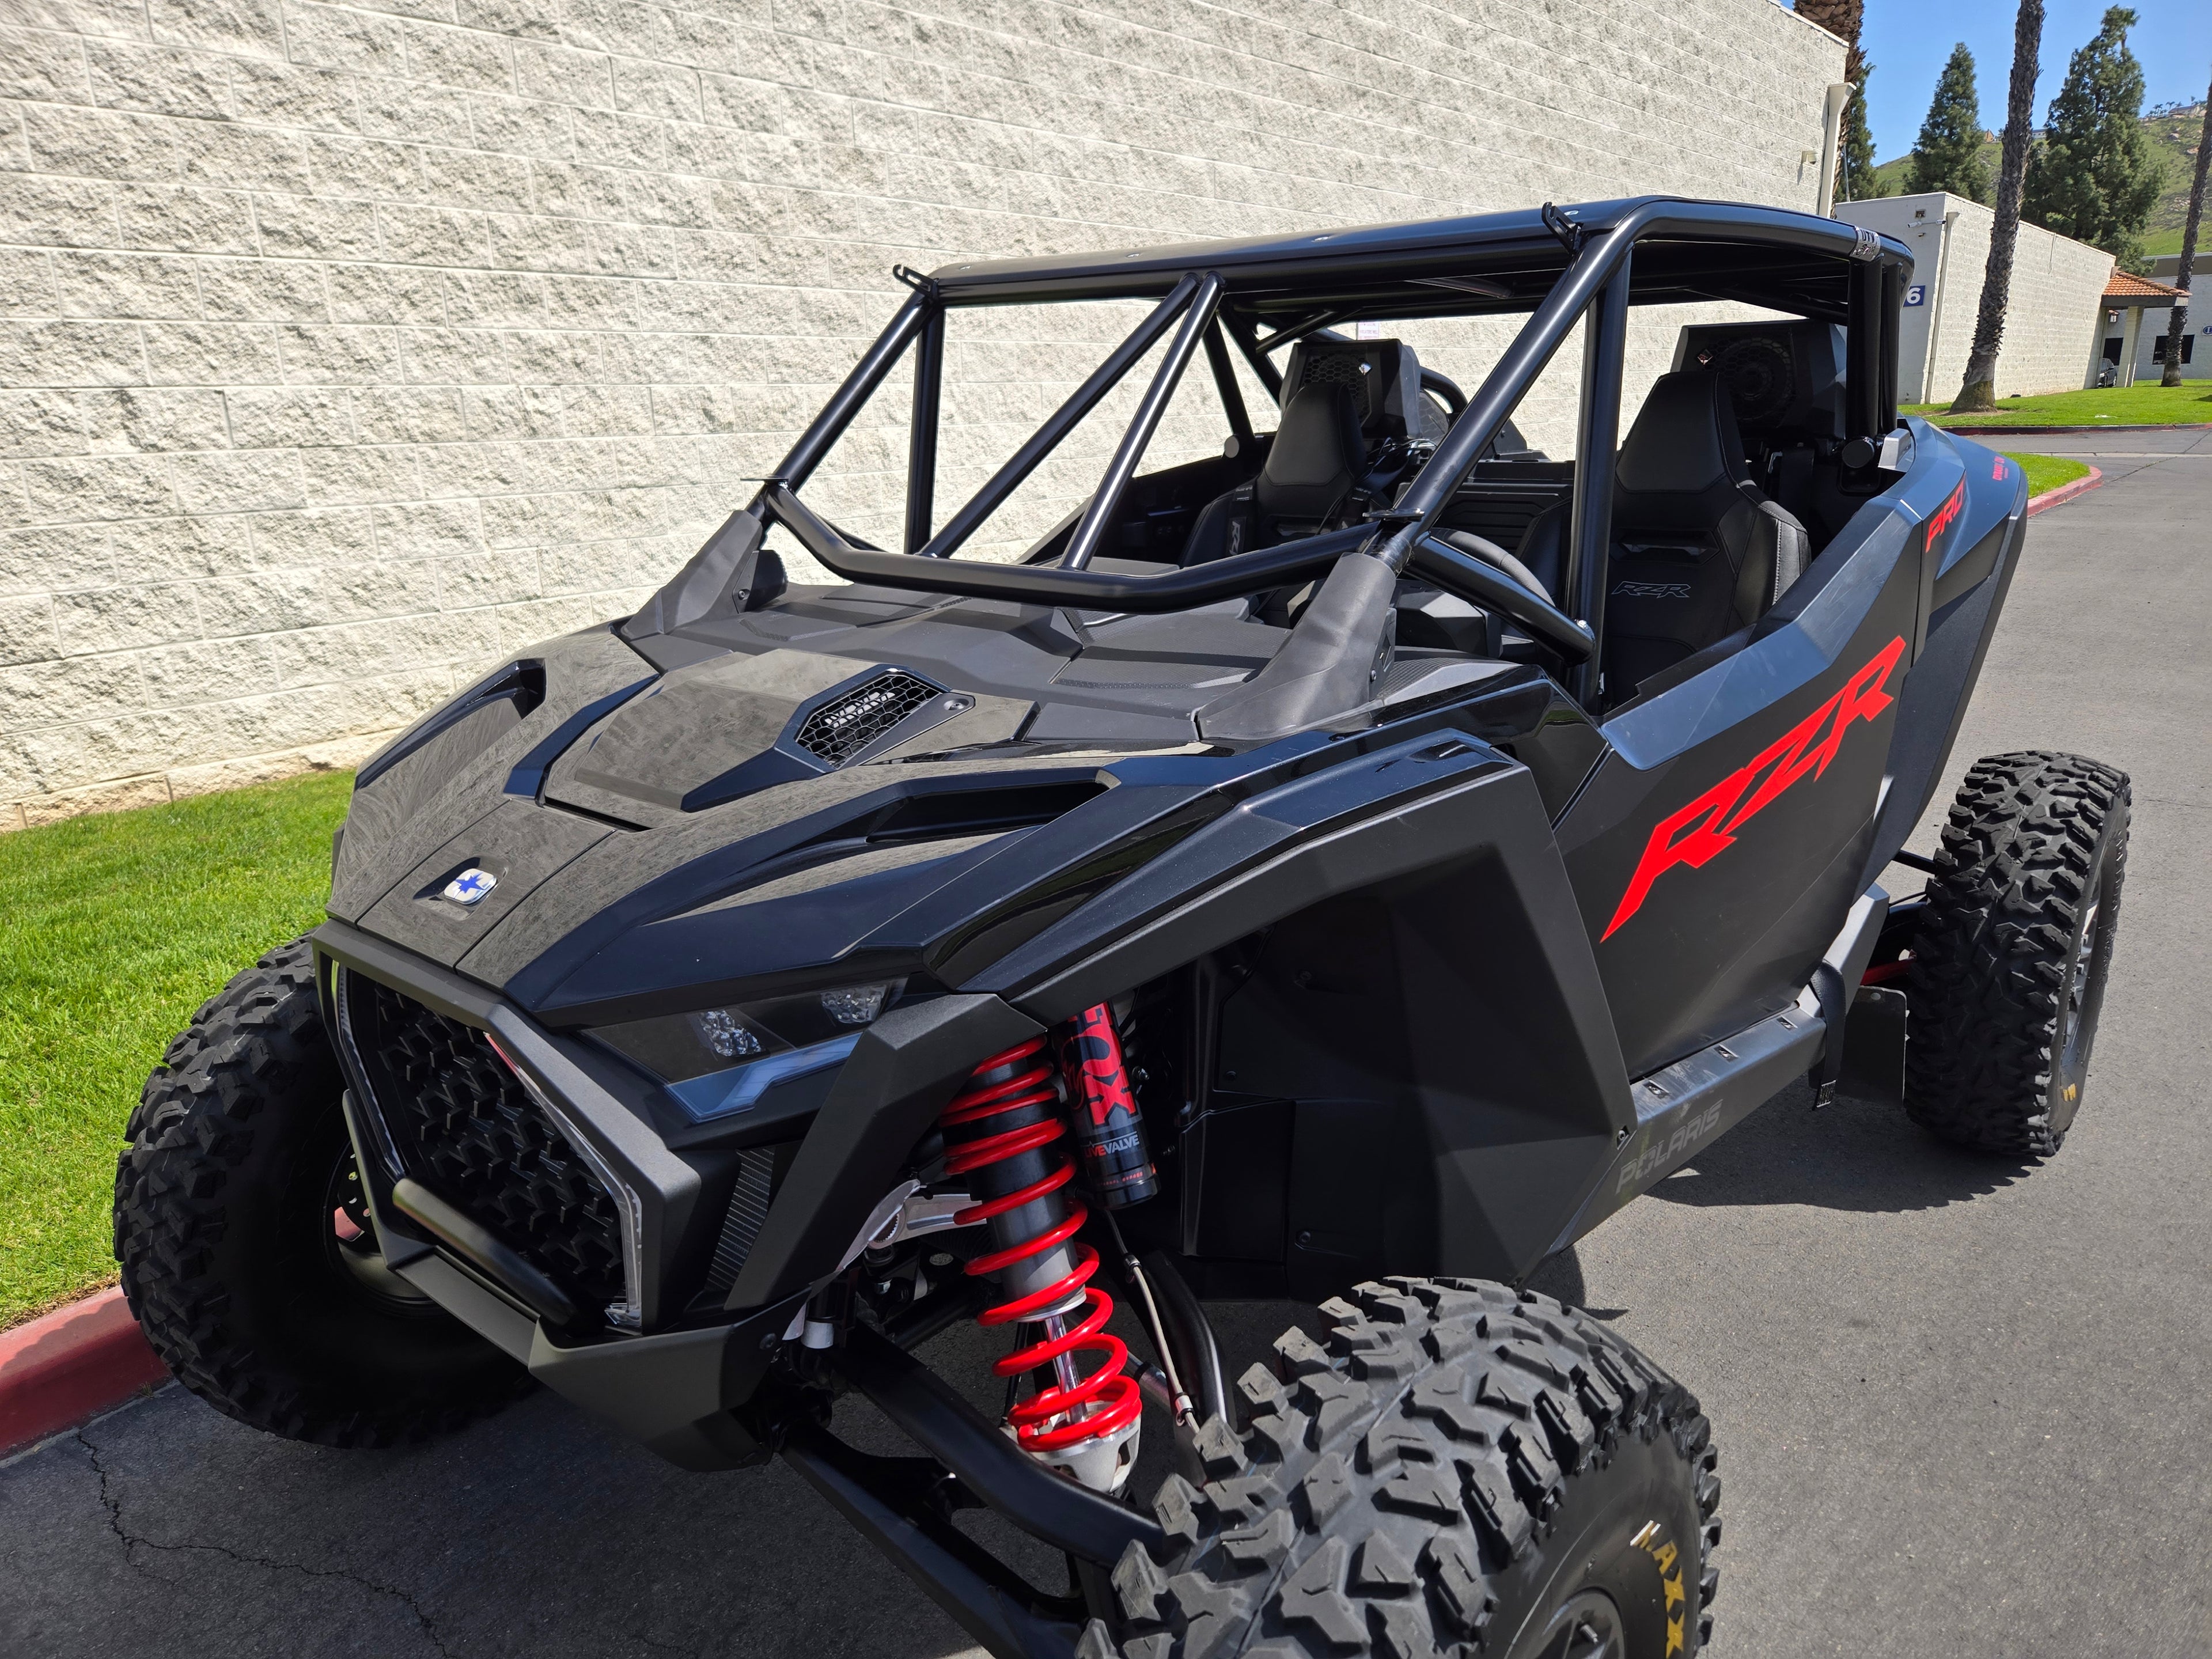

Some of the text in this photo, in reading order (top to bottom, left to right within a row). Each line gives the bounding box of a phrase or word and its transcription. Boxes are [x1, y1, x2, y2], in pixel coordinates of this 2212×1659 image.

[1907, 287, 1921, 304] 6
[1229, 521, 1240, 555] RZ
[1926, 479, 1964, 554] PRO
[1611, 581, 1692, 599] RZR
[1600, 635, 1907, 944] RZR
[1615, 1099, 1724, 1196] POLARIS
